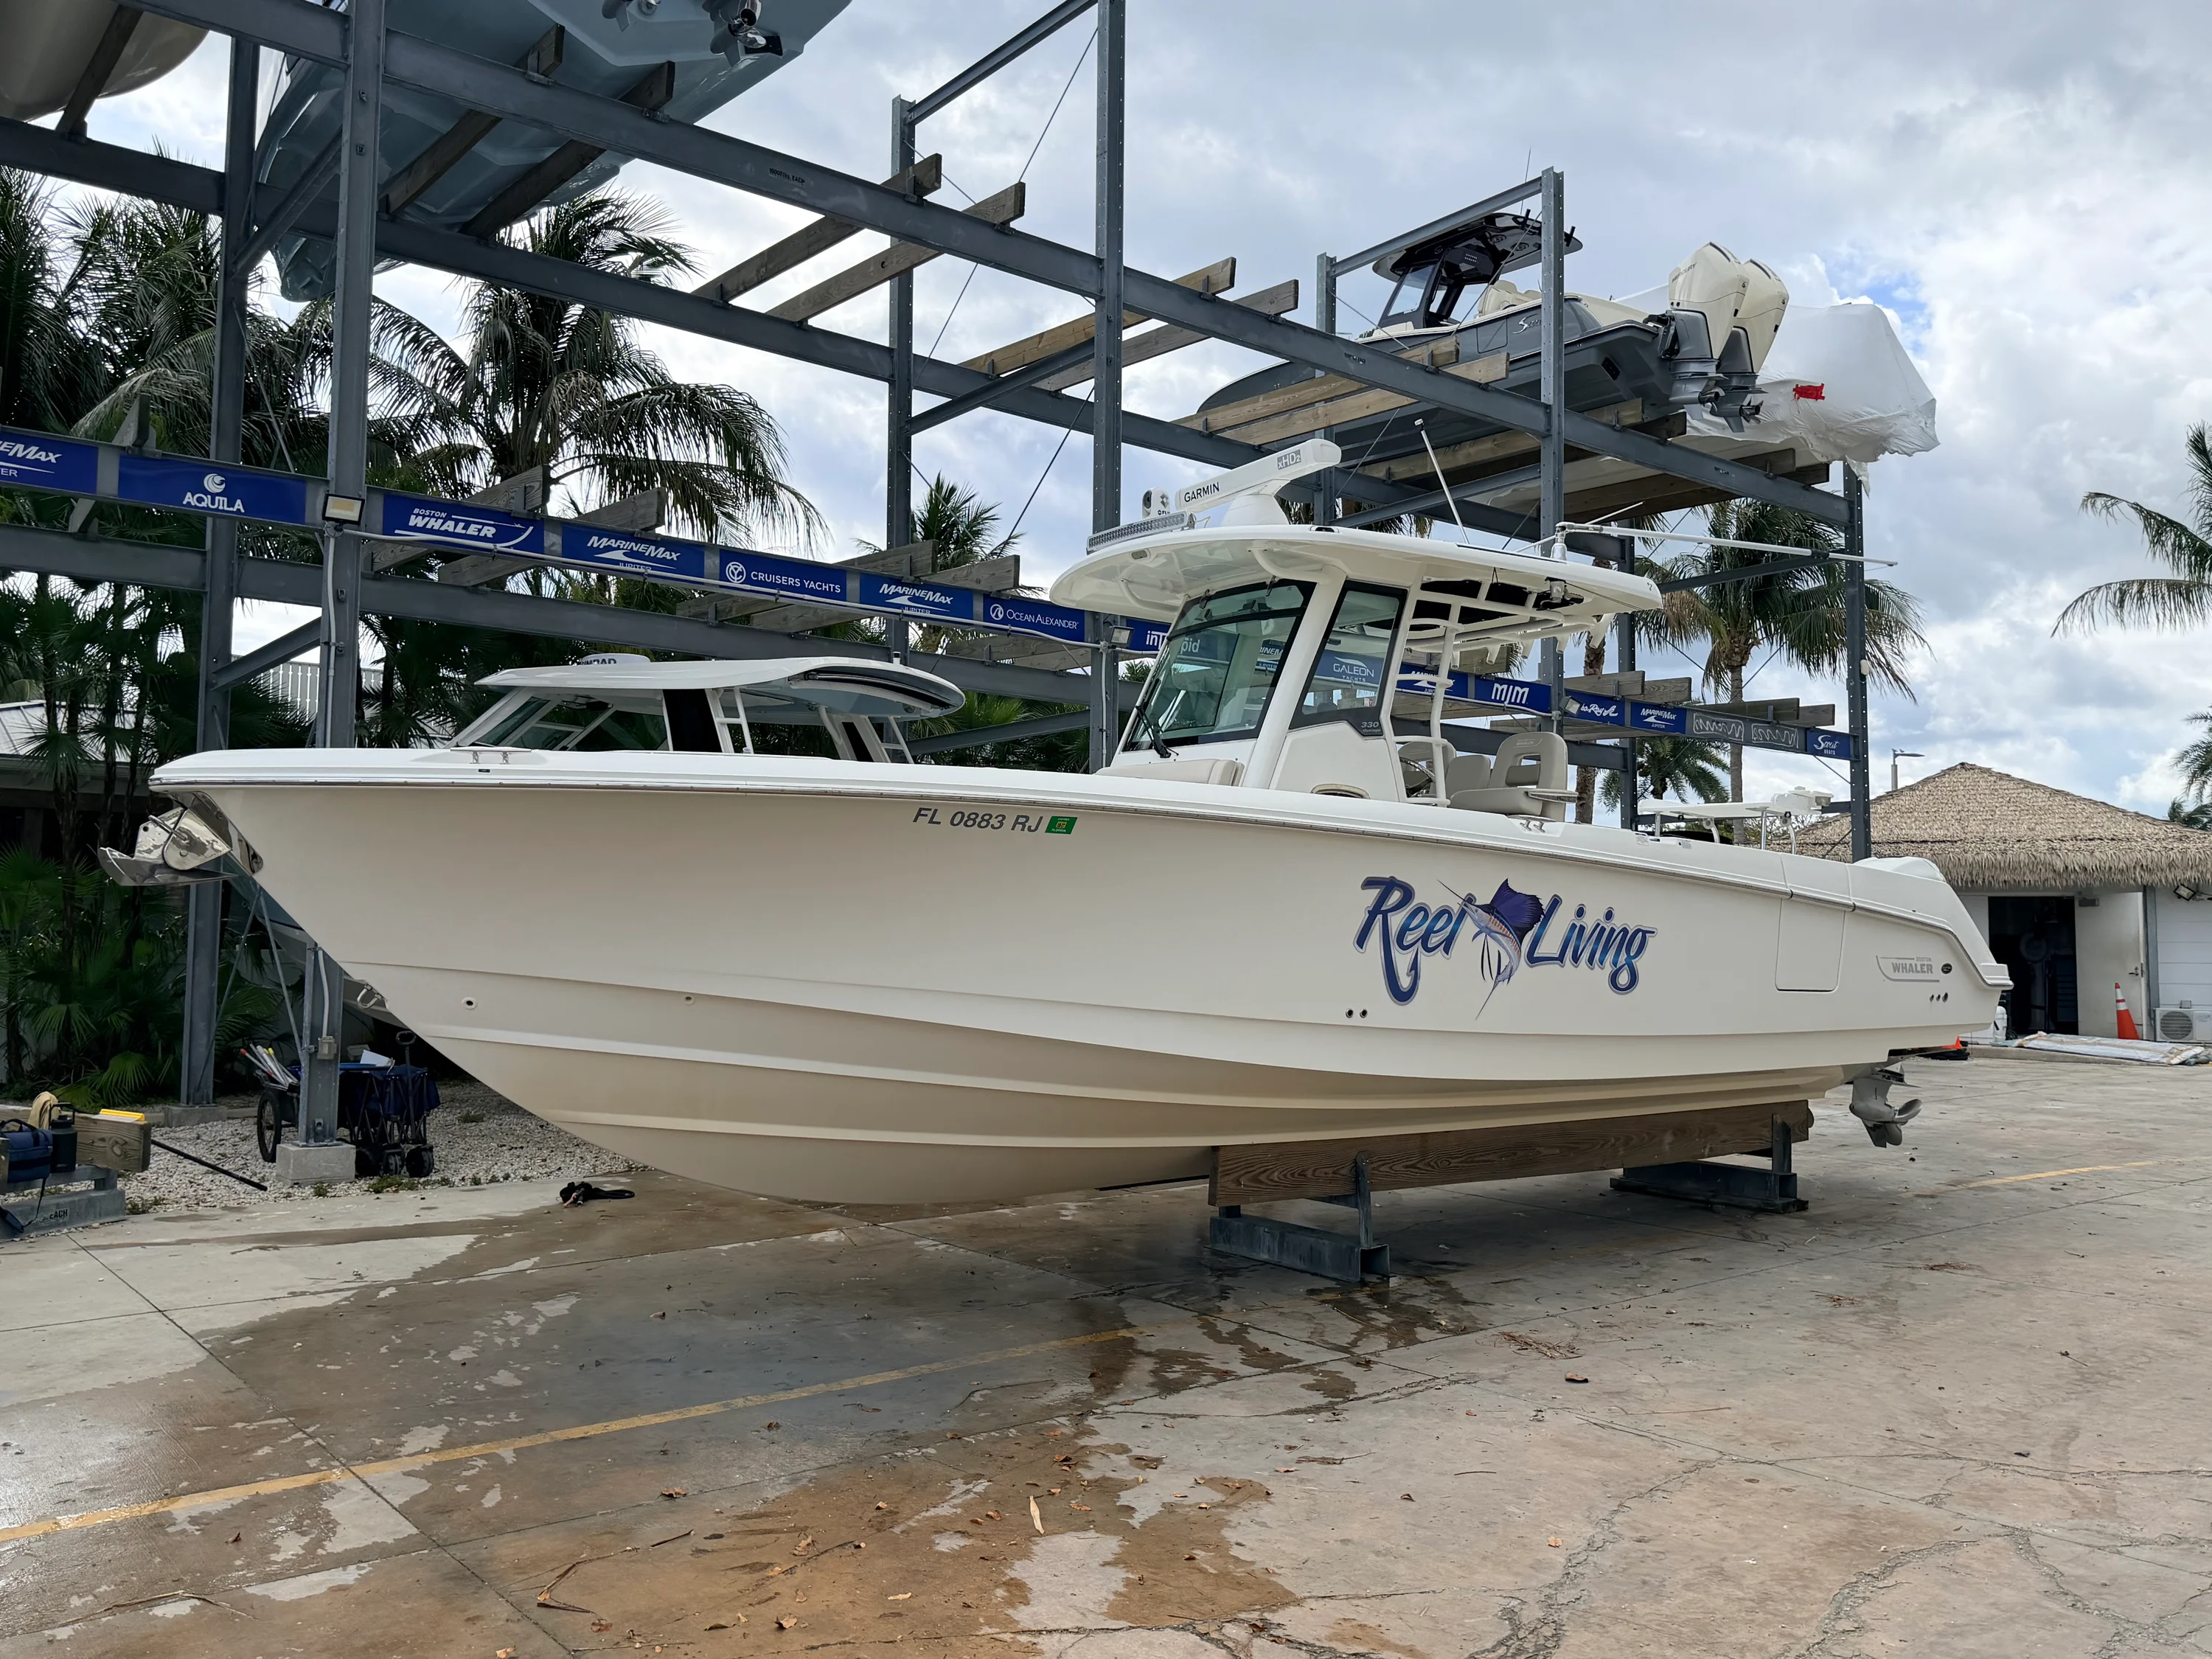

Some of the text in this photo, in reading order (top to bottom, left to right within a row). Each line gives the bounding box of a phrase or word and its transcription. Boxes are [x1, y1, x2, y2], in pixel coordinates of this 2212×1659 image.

[0, 441, 62, 463] EMAX
[1278, 453, 1301, 469] xHD2
[0, 467, 18, 477] ER
[182, 492, 245, 513] AQUILA
[1184, 481, 1220, 503] GARMIN
[413, 508, 447, 518] BOSTON
[408, 515, 496, 538] WHALER
[751, 571, 841, 593] CRUISERS YACHTS
[1006, 609, 1077, 630] OCEAN ALEXANDER
[1333, 663, 1374, 677] GALEON
[913, 807, 1043, 832] FL 0883 RJ
[1353, 875, 1658, 1006] Reel Living
[1891, 962, 1933, 974] WHALER
